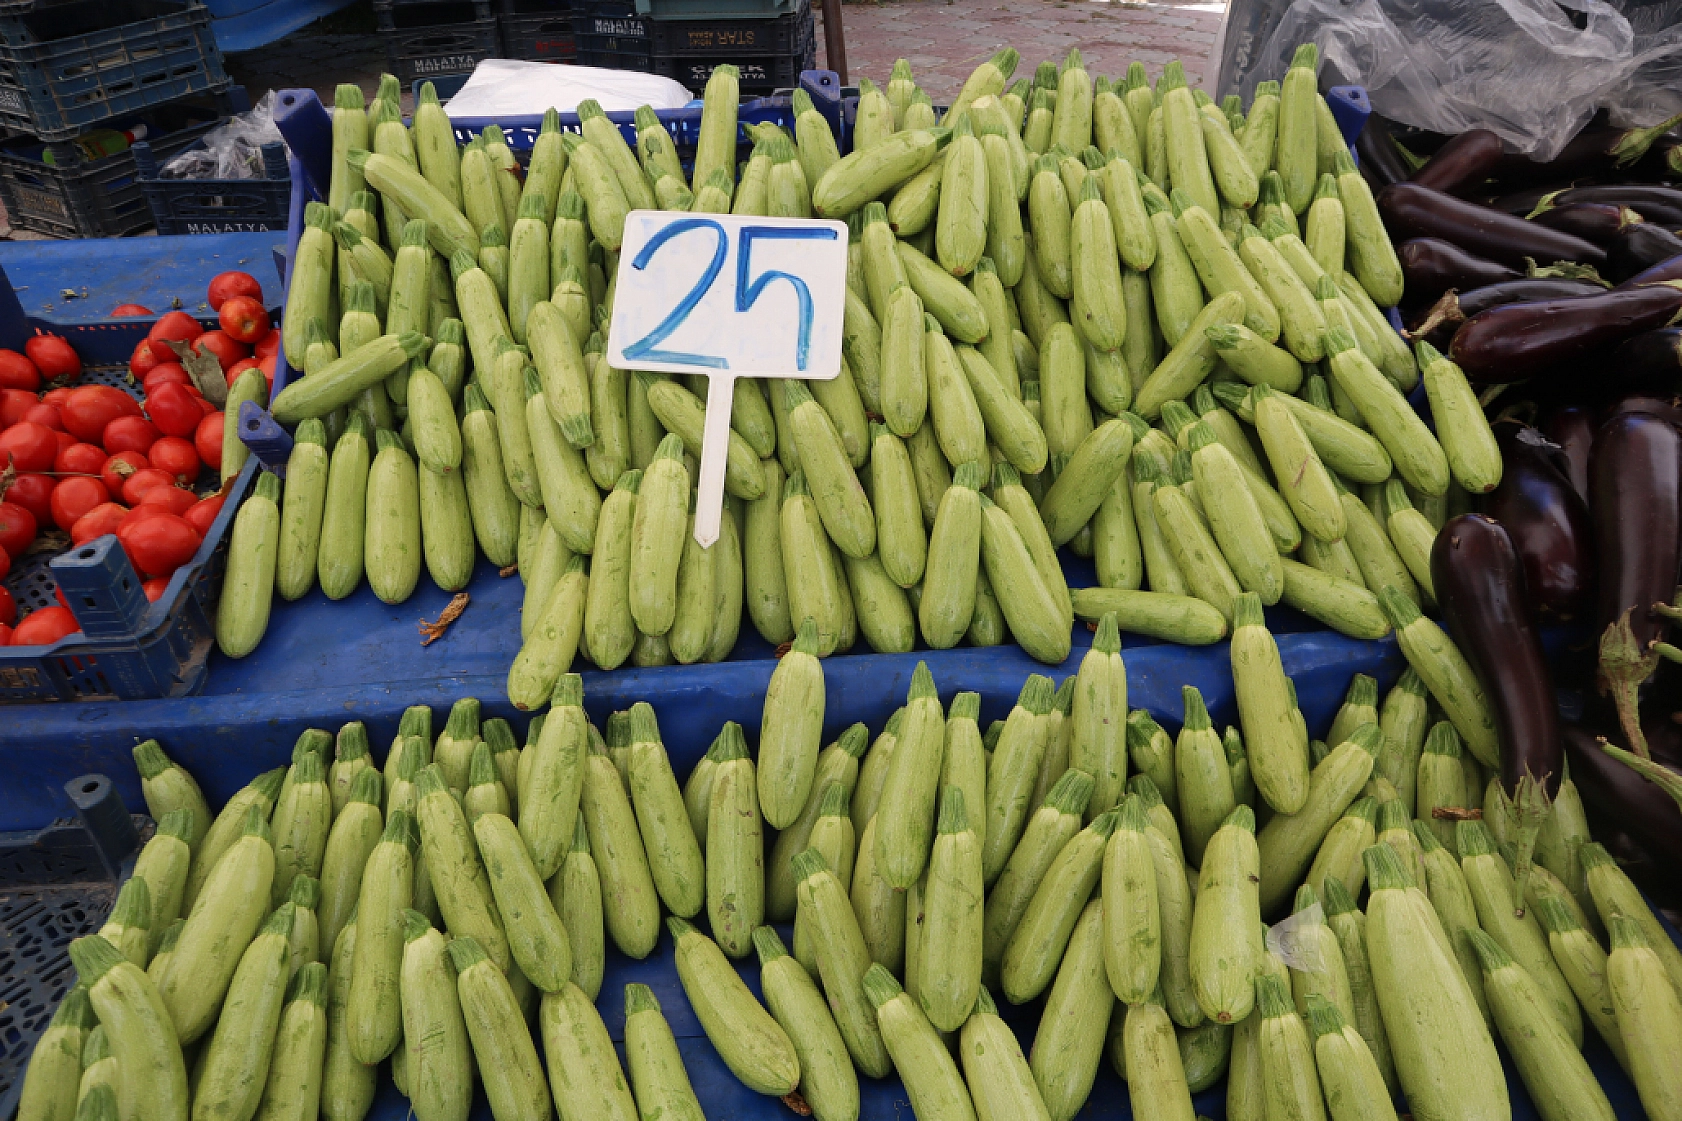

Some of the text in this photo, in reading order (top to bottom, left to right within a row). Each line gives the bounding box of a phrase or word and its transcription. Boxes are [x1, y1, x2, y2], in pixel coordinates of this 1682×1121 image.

[717, 31, 754, 45] STAR
[187, 223, 269, 233] MALATYA
[621, 218, 838, 371] 25
